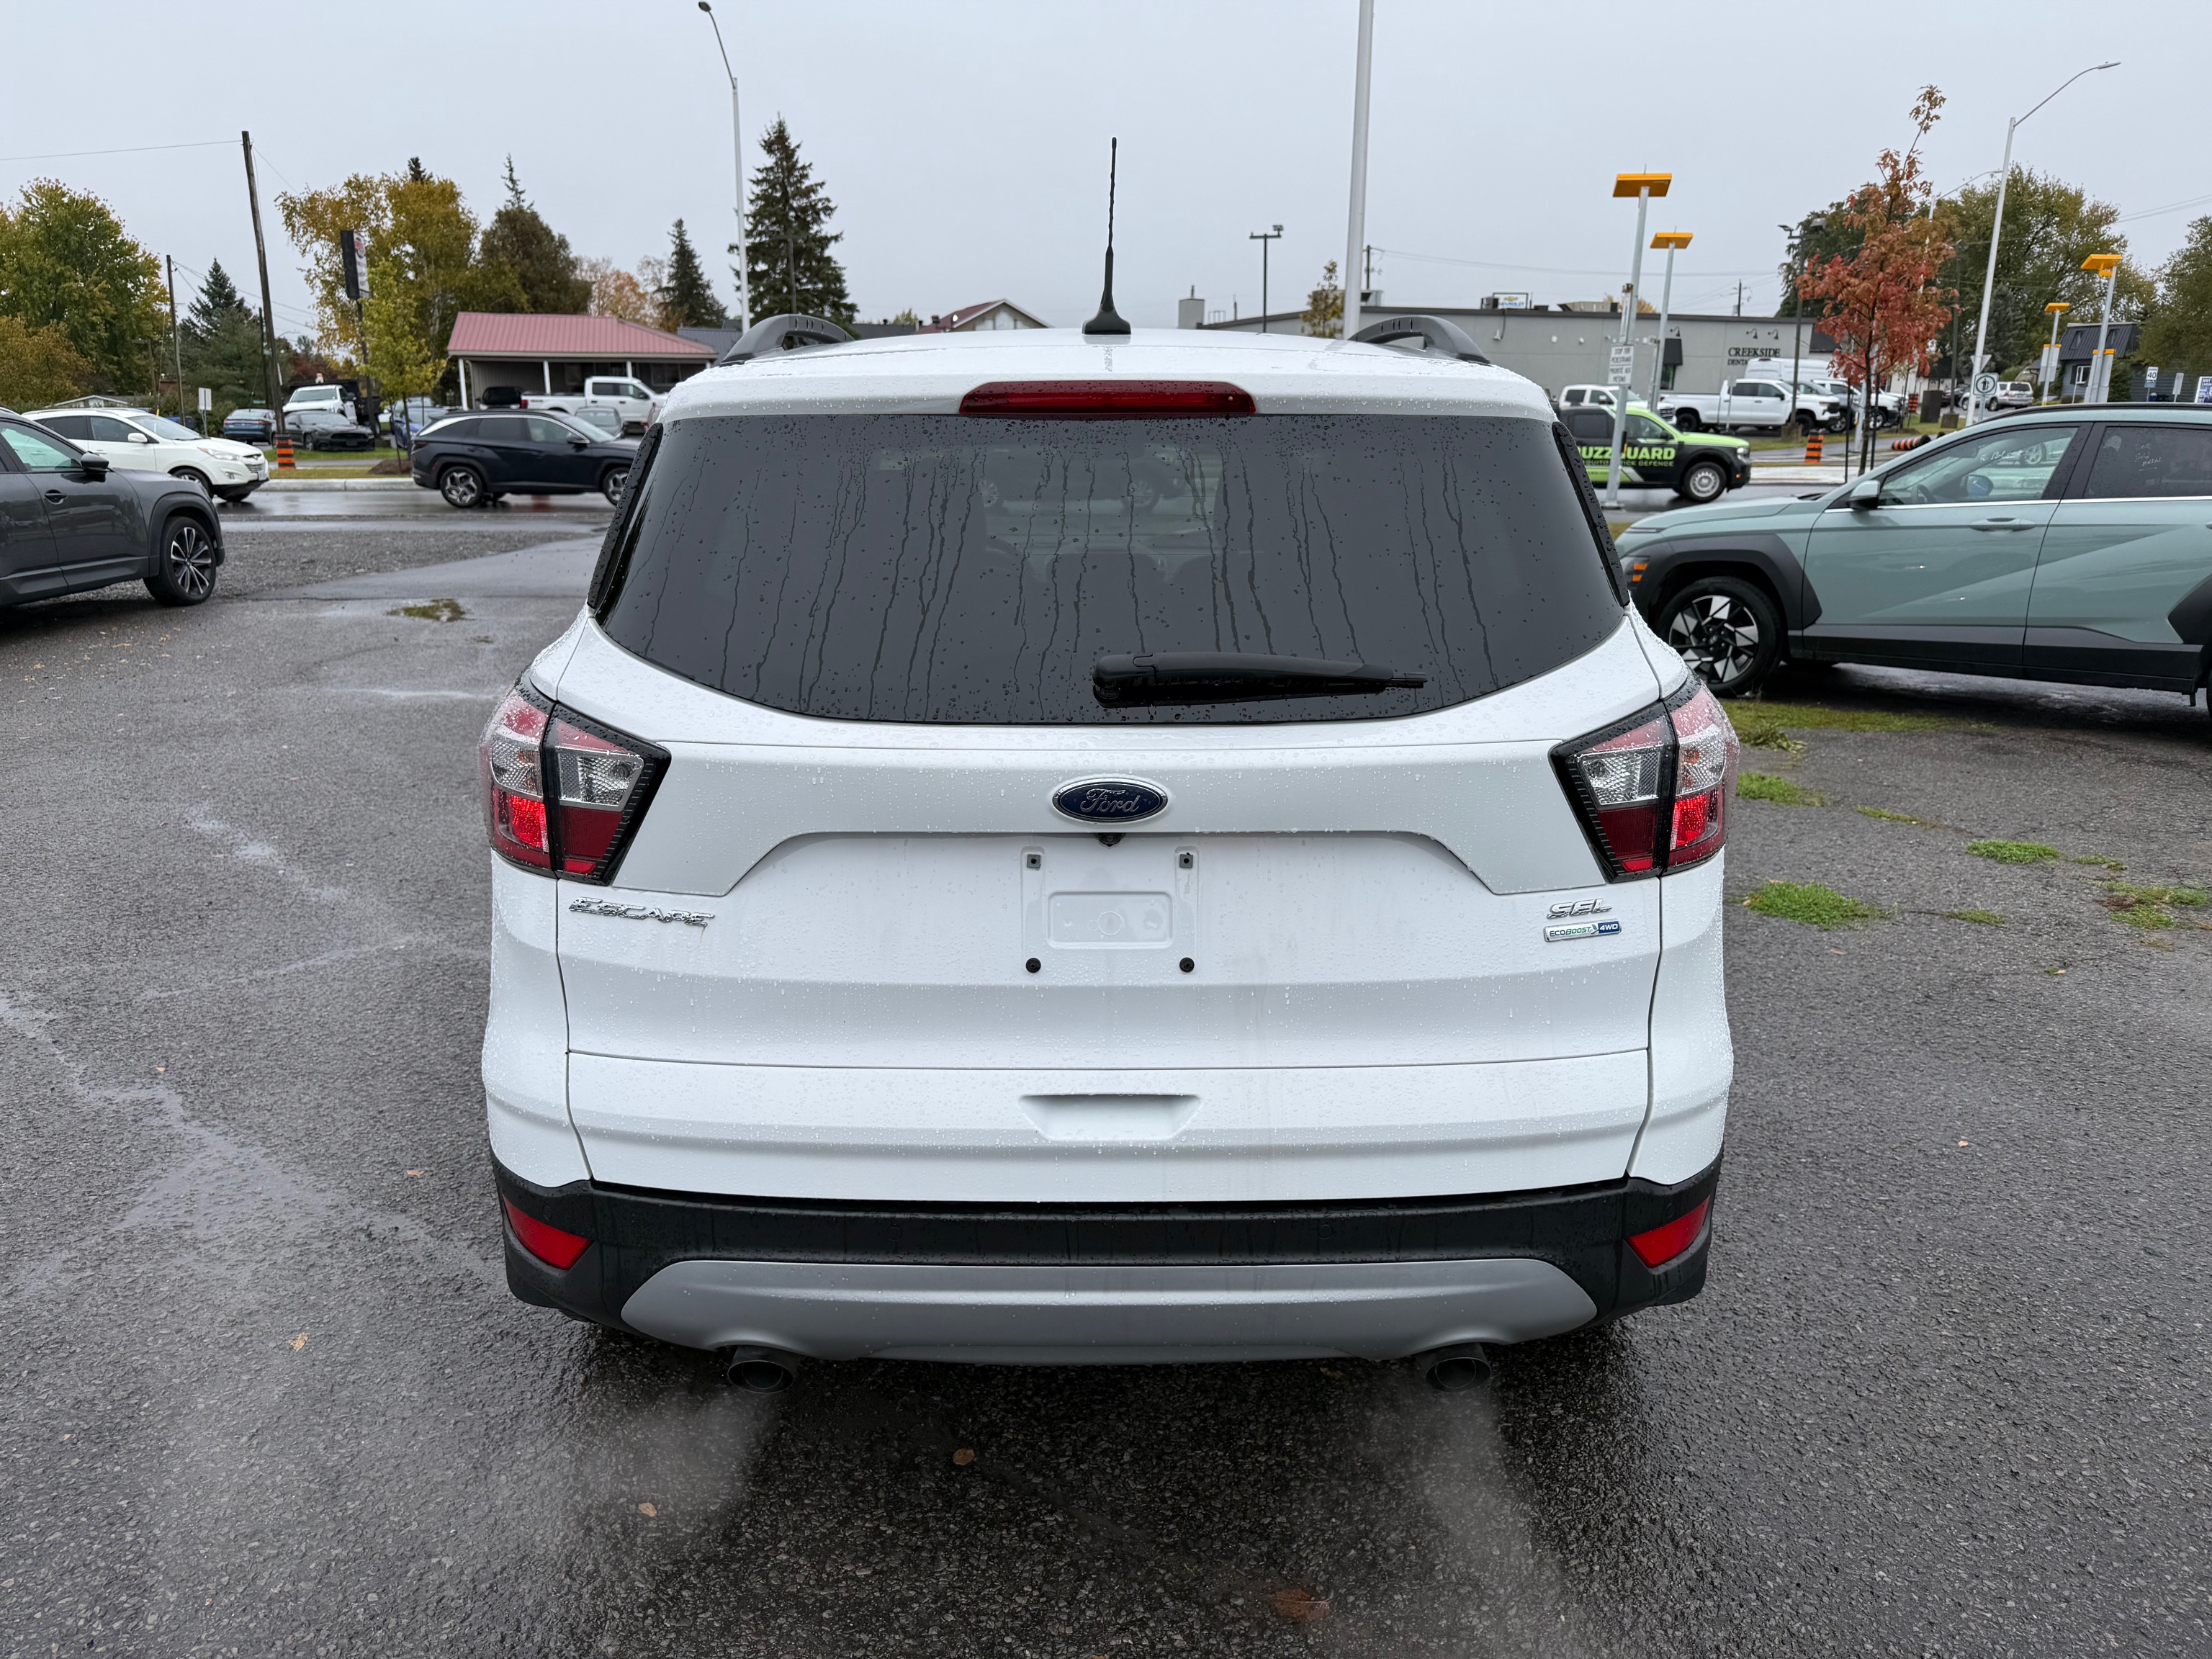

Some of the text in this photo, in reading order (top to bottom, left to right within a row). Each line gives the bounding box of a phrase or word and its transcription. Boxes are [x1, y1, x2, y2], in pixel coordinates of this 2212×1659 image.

[1728, 346, 1781, 357] CREEKSIDE
[1080, 788, 1141, 813] Ford
[568, 896, 716, 927] ESCAPE
[1547, 898, 1612, 920] SEL
[1599, 922, 1618, 931] 4WD
